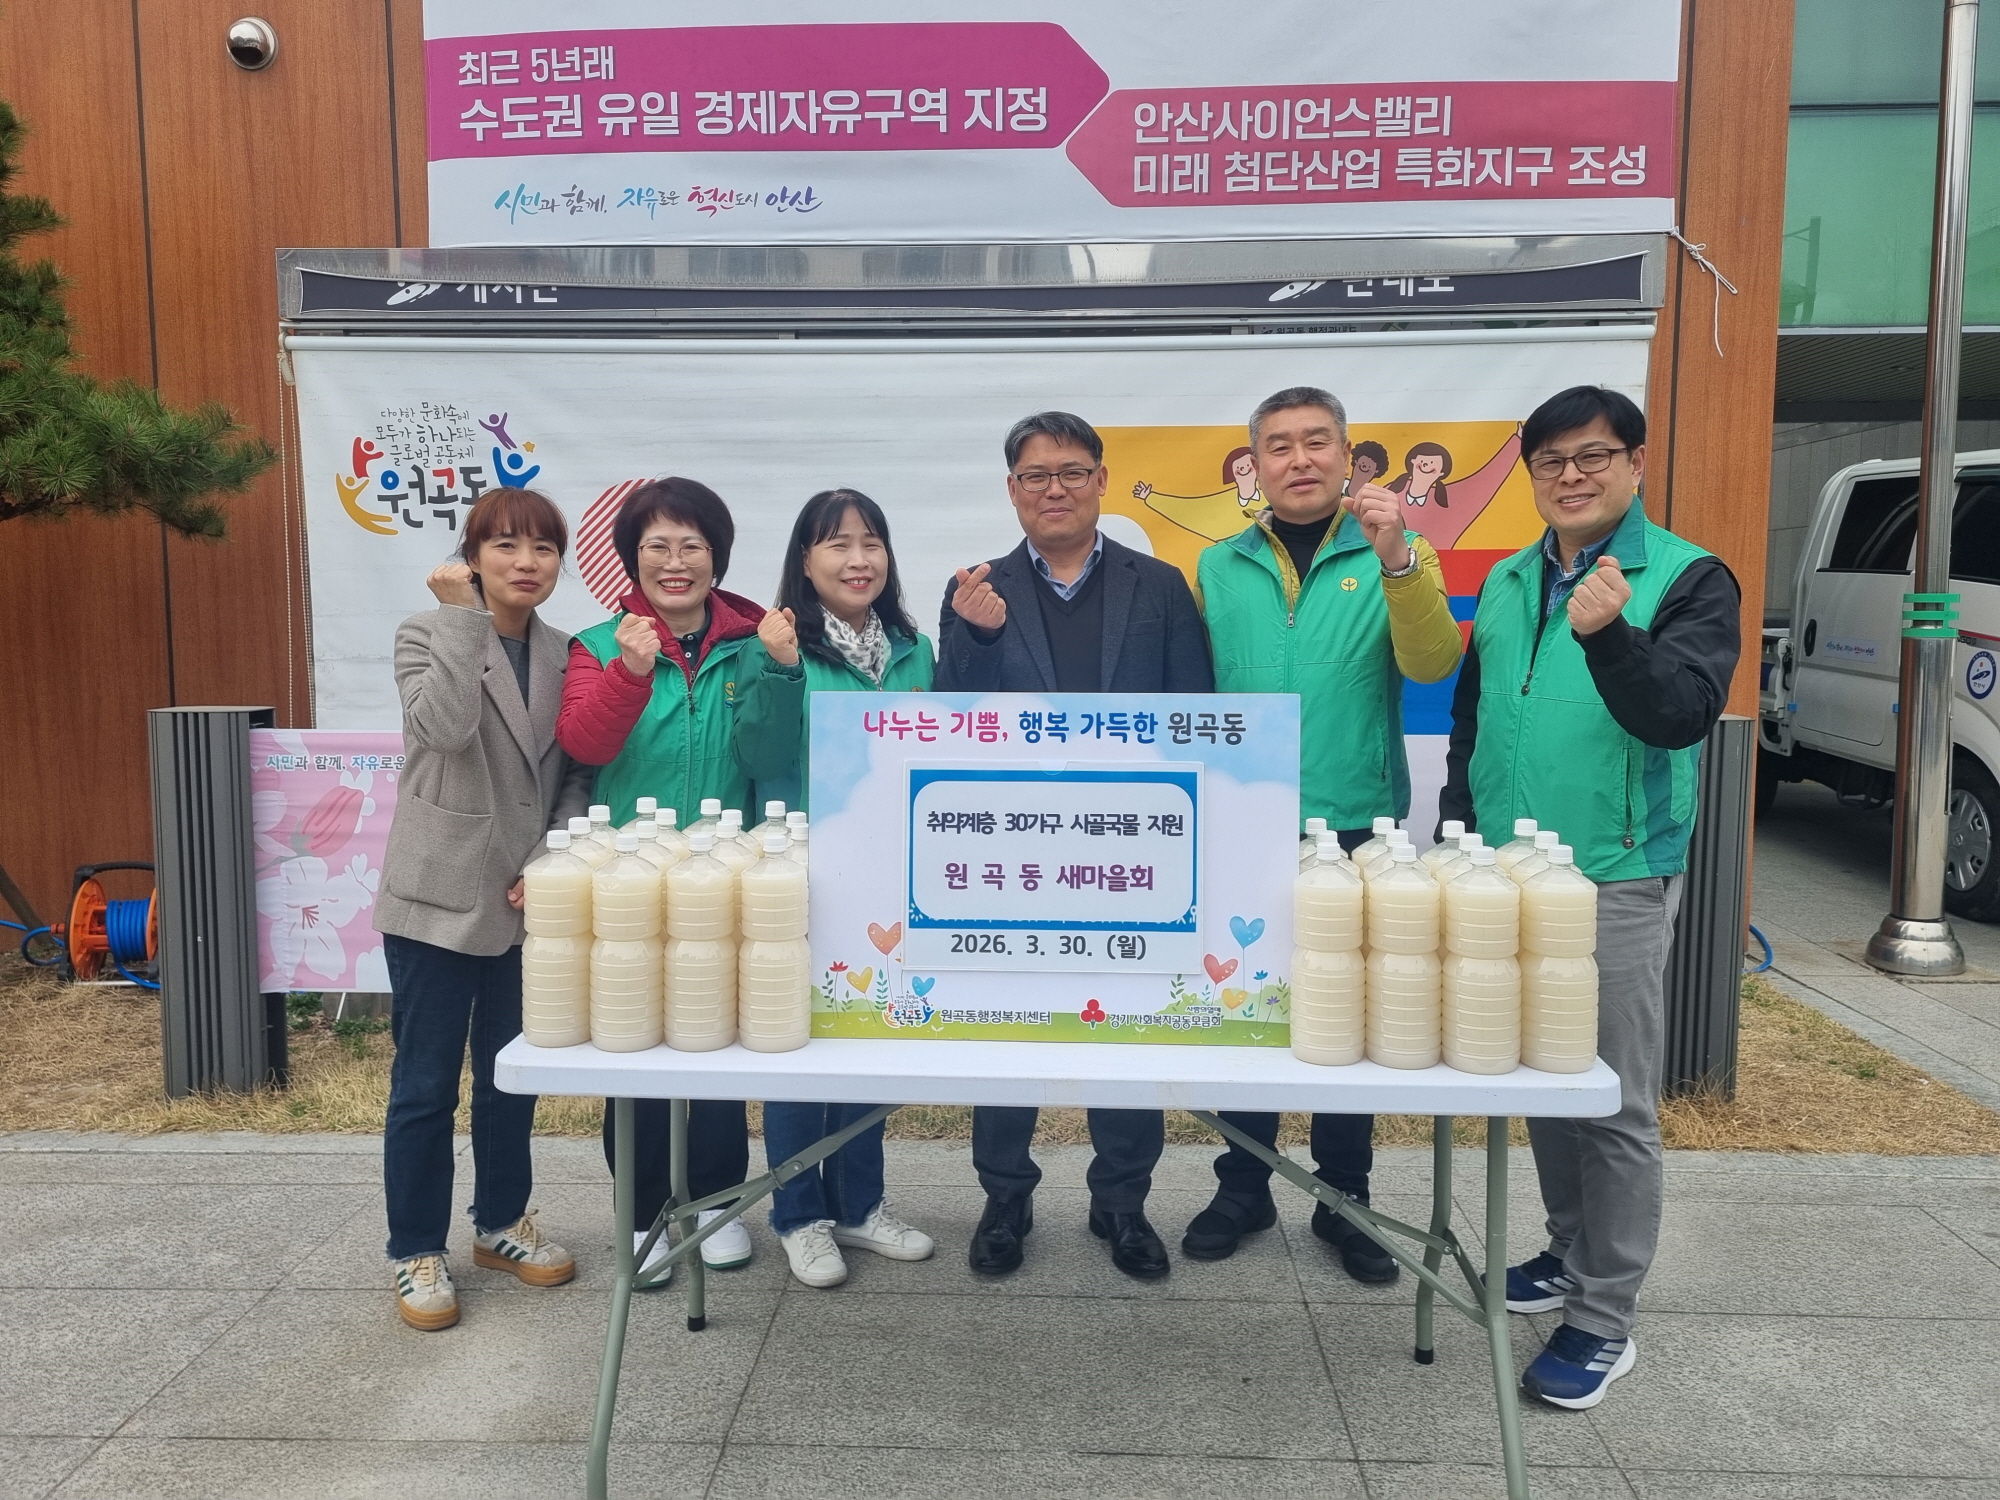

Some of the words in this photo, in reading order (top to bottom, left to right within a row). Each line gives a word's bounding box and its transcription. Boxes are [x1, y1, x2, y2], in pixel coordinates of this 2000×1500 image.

[458, 49, 520, 86] 최근
[531, 46, 614, 83] 5년래
[458, 94, 582, 142] 수도권
[598, 91, 680, 137] 유일
[695, 88, 948, 136] 경제자유구역
[964, 86, 1049, 134] 지정
[1134, 96, 1452, 144] 안산사이언스밸리
[1133, 153, 1209, 195] 미래
[1224, 149, 1381, 192] 첨단산업
[1395, 146, 1553, 189] 특화지구
[1567, 144, 1647, 186] 조성
[494, 183, 560, 225] 시민과
[617, 186, 681, 221] 자유로운
[687, 185, 759, 219] 혁신도시
[765, 185, 823, 213] 안산
[380, 407, 416, 423] 다양한
[419, 401, 470, 425] 문화속에
[375, 425, 412, 443] 모두가
[416, 424, 477, 444] 하나되는
[389, 444, 431, 469] 글로벌
[434, 444, 475, 465] 공동체
[863, 711, 940, 743] 나누는
[949, 711, 1009, 743] 기쁨,
[1018, 711, 1068, 744] 행복
[1079, 711, 1158, 744] 가득한
[1166, 711, 1247, 746] 원곡동
[267, 756, 308, 770] 시민과
[315, 756, 346, 771] 함께,
[926, 811, 998, 836] 취약계층
[1004, 811, 1063, 836] 30가구
[1070, 812, 1141, 837] 사골국물
[1147, 813, 1184, 838] 지원
[1056, 864, 1155, 893] 새마을회
[950, 934, 1013, 956] 2026.
[1025, 934, 1046, 957] 3.
[1058, 935, 1093, 958] 30.
[1106, 934, 1148, 961] (월)
[940, 1009, 1051, 1025] 원곡동행정복지센터
